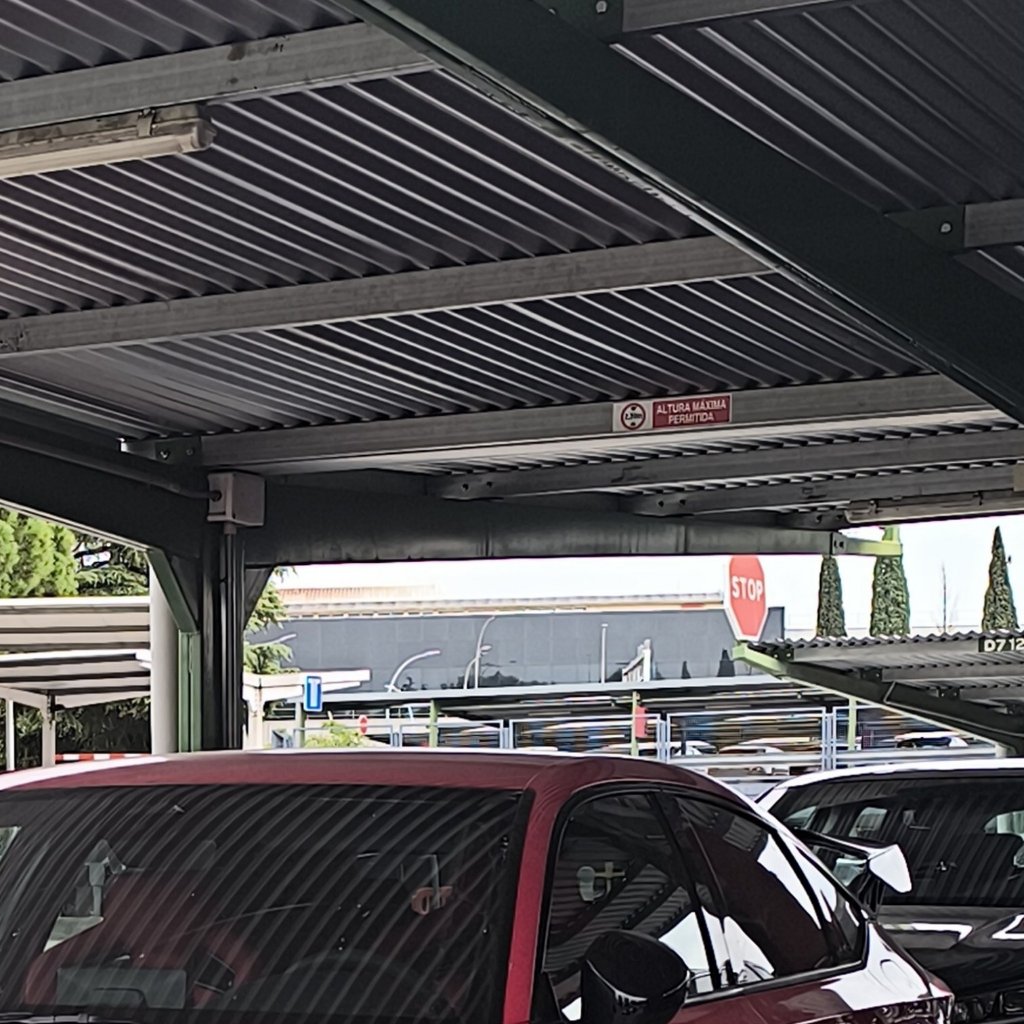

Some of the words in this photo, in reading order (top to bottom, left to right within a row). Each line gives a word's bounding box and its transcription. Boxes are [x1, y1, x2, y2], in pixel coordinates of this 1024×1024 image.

[656, 403, 690, 415] ALTURA
[692, 399, 727, 412] MÁXIMA
[668, 411, 715, 425] PERMITIDA
[731, 575, 764, 602] STOP
